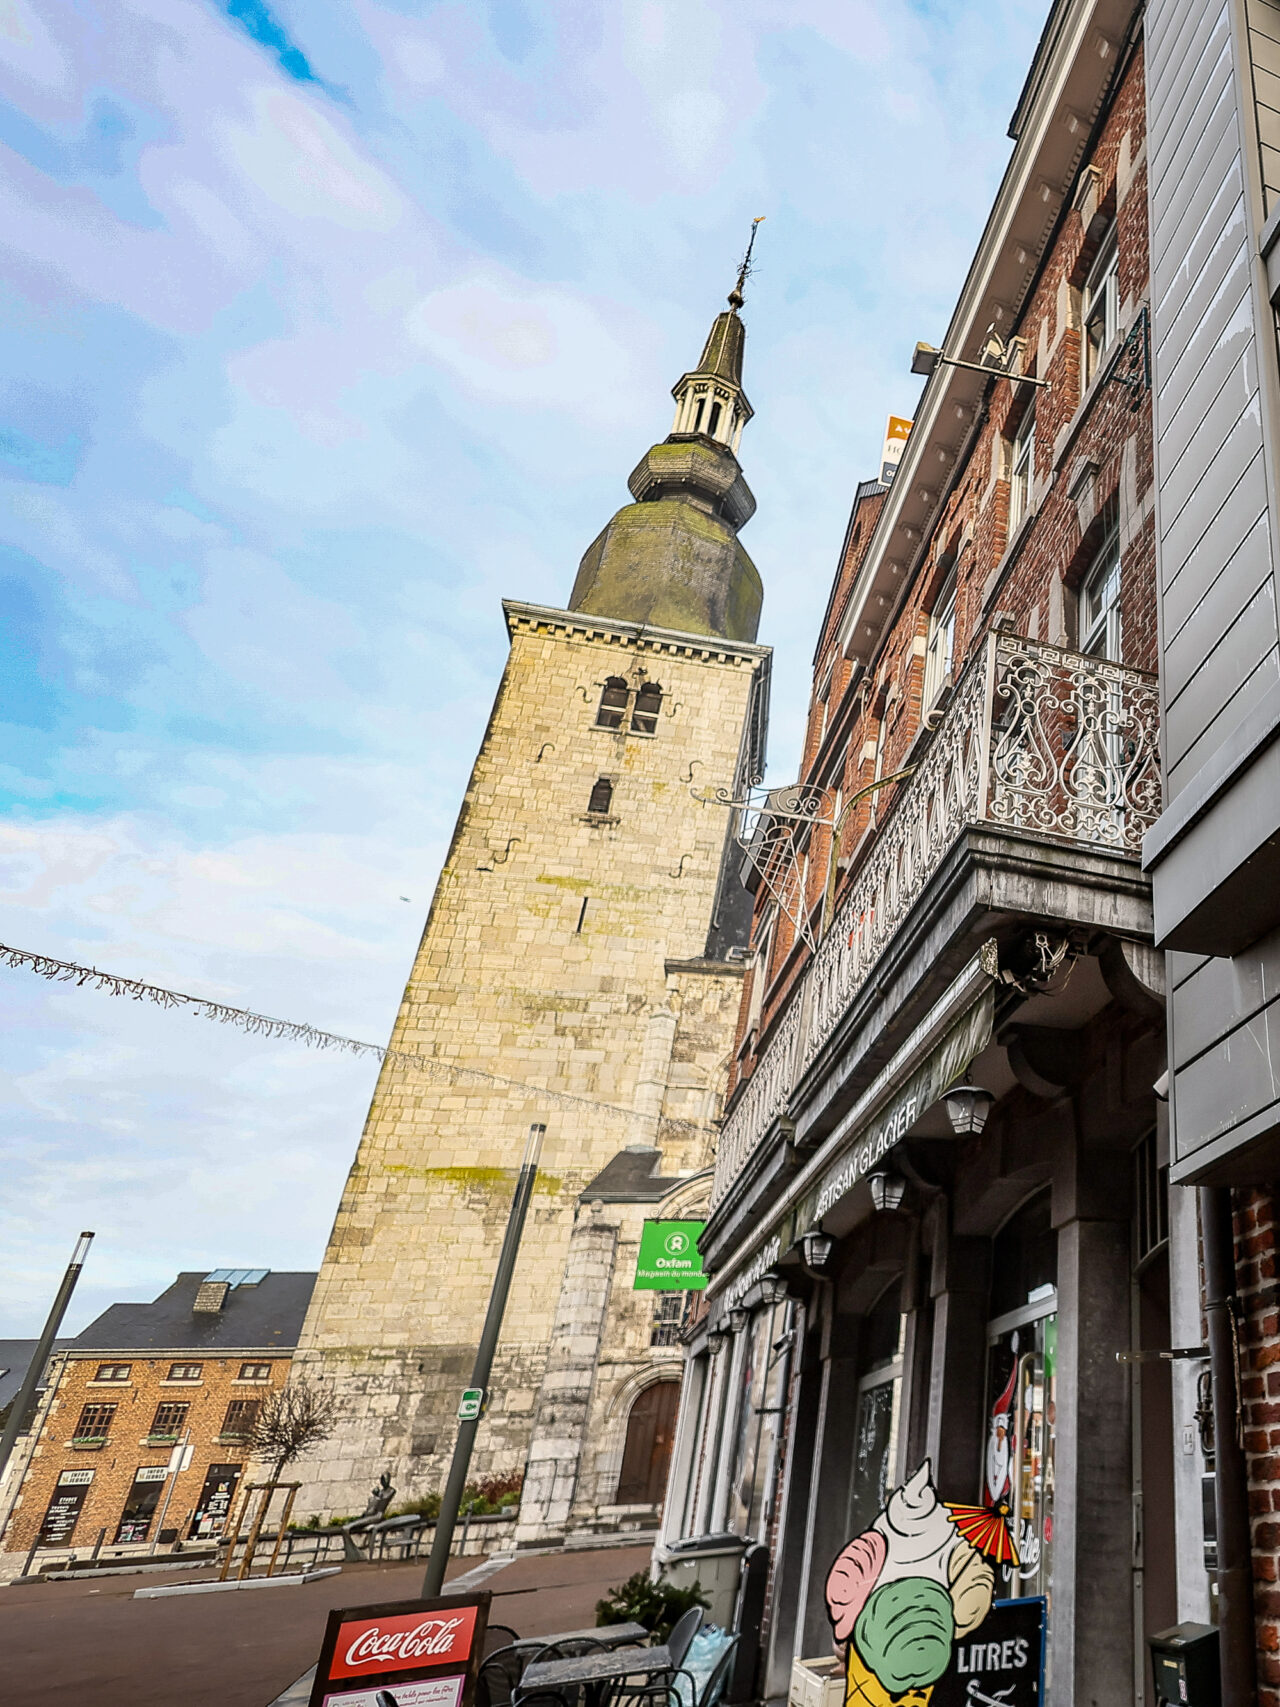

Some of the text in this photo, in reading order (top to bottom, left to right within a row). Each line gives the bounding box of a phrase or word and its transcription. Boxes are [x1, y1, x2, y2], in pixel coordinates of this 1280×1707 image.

[813, 1096, 917, 1222] ARTISAN GLACIER
[637, 1269, 671, 1279] Magasin
[672, 1270, 682, 1278] du
[655, 1257, 693, 1269] Oxfam
[345, 1617, 464, 1666] Coca-Cola
[957, 1637, 1029, 1673] LITRES
